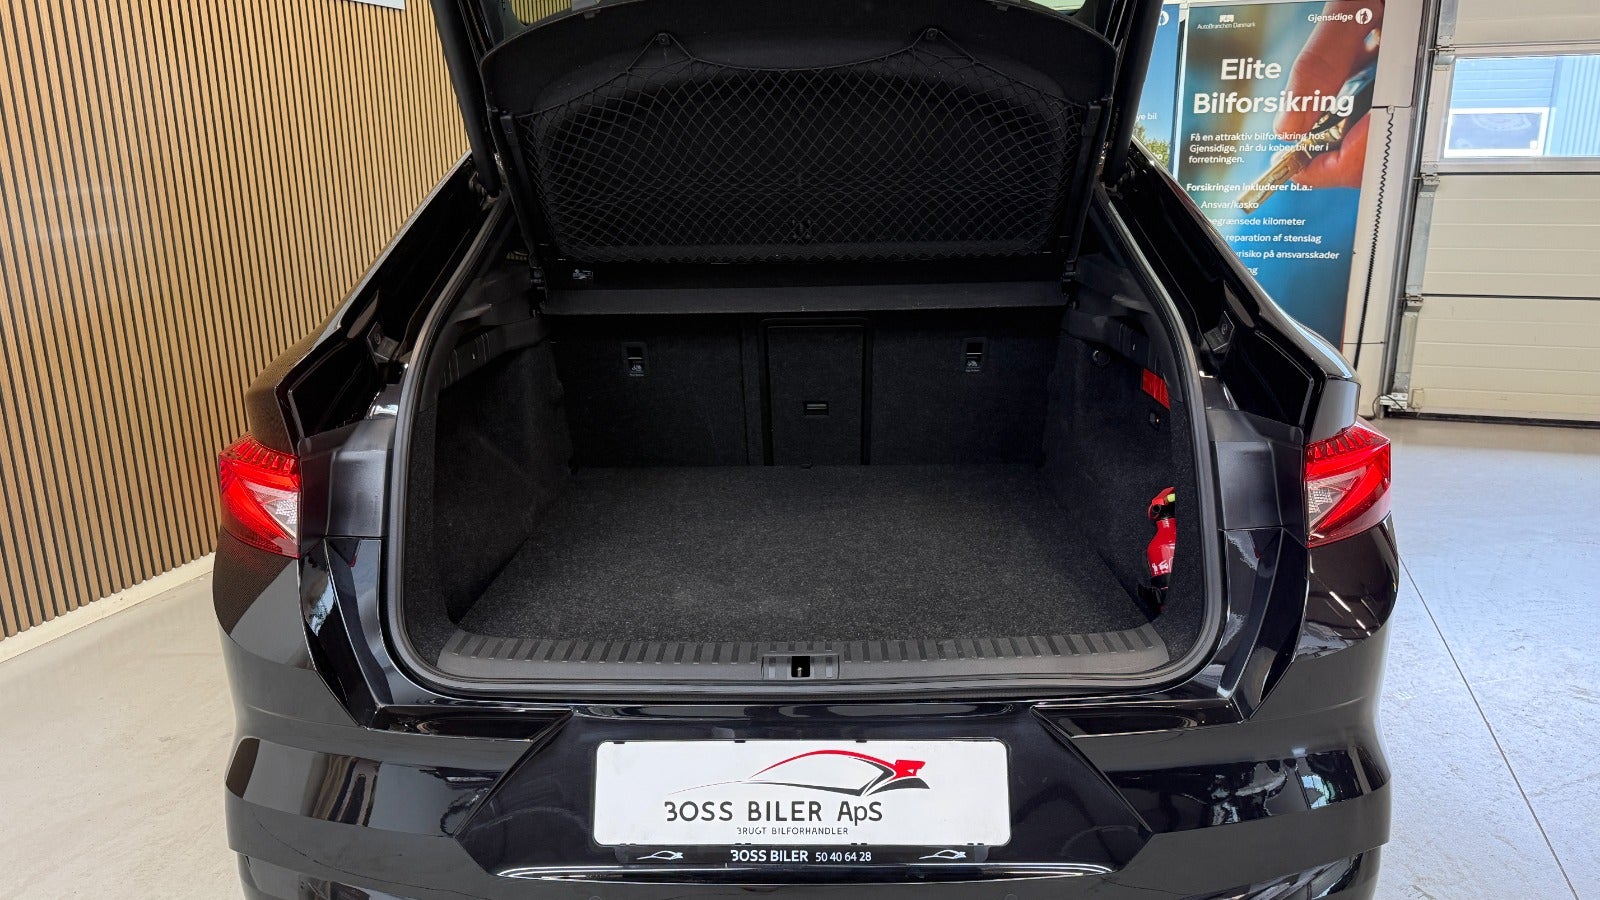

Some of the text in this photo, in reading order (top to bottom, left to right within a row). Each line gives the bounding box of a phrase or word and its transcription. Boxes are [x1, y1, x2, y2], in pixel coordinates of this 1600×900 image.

[1307, 13, 1353, 22] Gjensidige
[1220, 58, 1282, 80] Elite
[1193, 89, 1355, 116] Bilforsikring
[1147, 112, 1157, 120] bil
[1190, 133, 1201, 141] Få
[1254, 132, 1307, 140] bilforsikring
[1189, 145, 1237, 153] Gjensidige,
[1308, 143, 1323, 151] her
[1188, 155, 1245, 164] forretningen.
[1186, 183, 1240, 192] Forsikringen
[1242, 183, 1289, 191] inkluderer
[1200, 201, 1260, 209] Ansvar/kasko
[1262, 217, 1306, 226] kilometer
[1225, 234, 1322, 244] reparation af stenslag
[1263, 249, 1275, 259] på
[1276, 251, 1340, 259] ansvarsskader
[747, 800, 822, 821] BILER
[837, 800, 883, 826] ApS
[771, 826, 849, 835] BILFORHANDLER
[770, 849, 809, 862] BILER
[815, 851, 828, 862] 50
[829, 851, 843, 862] 40
[844, 851, 857, 862] 64
[859, 851, 872, 862] 28
